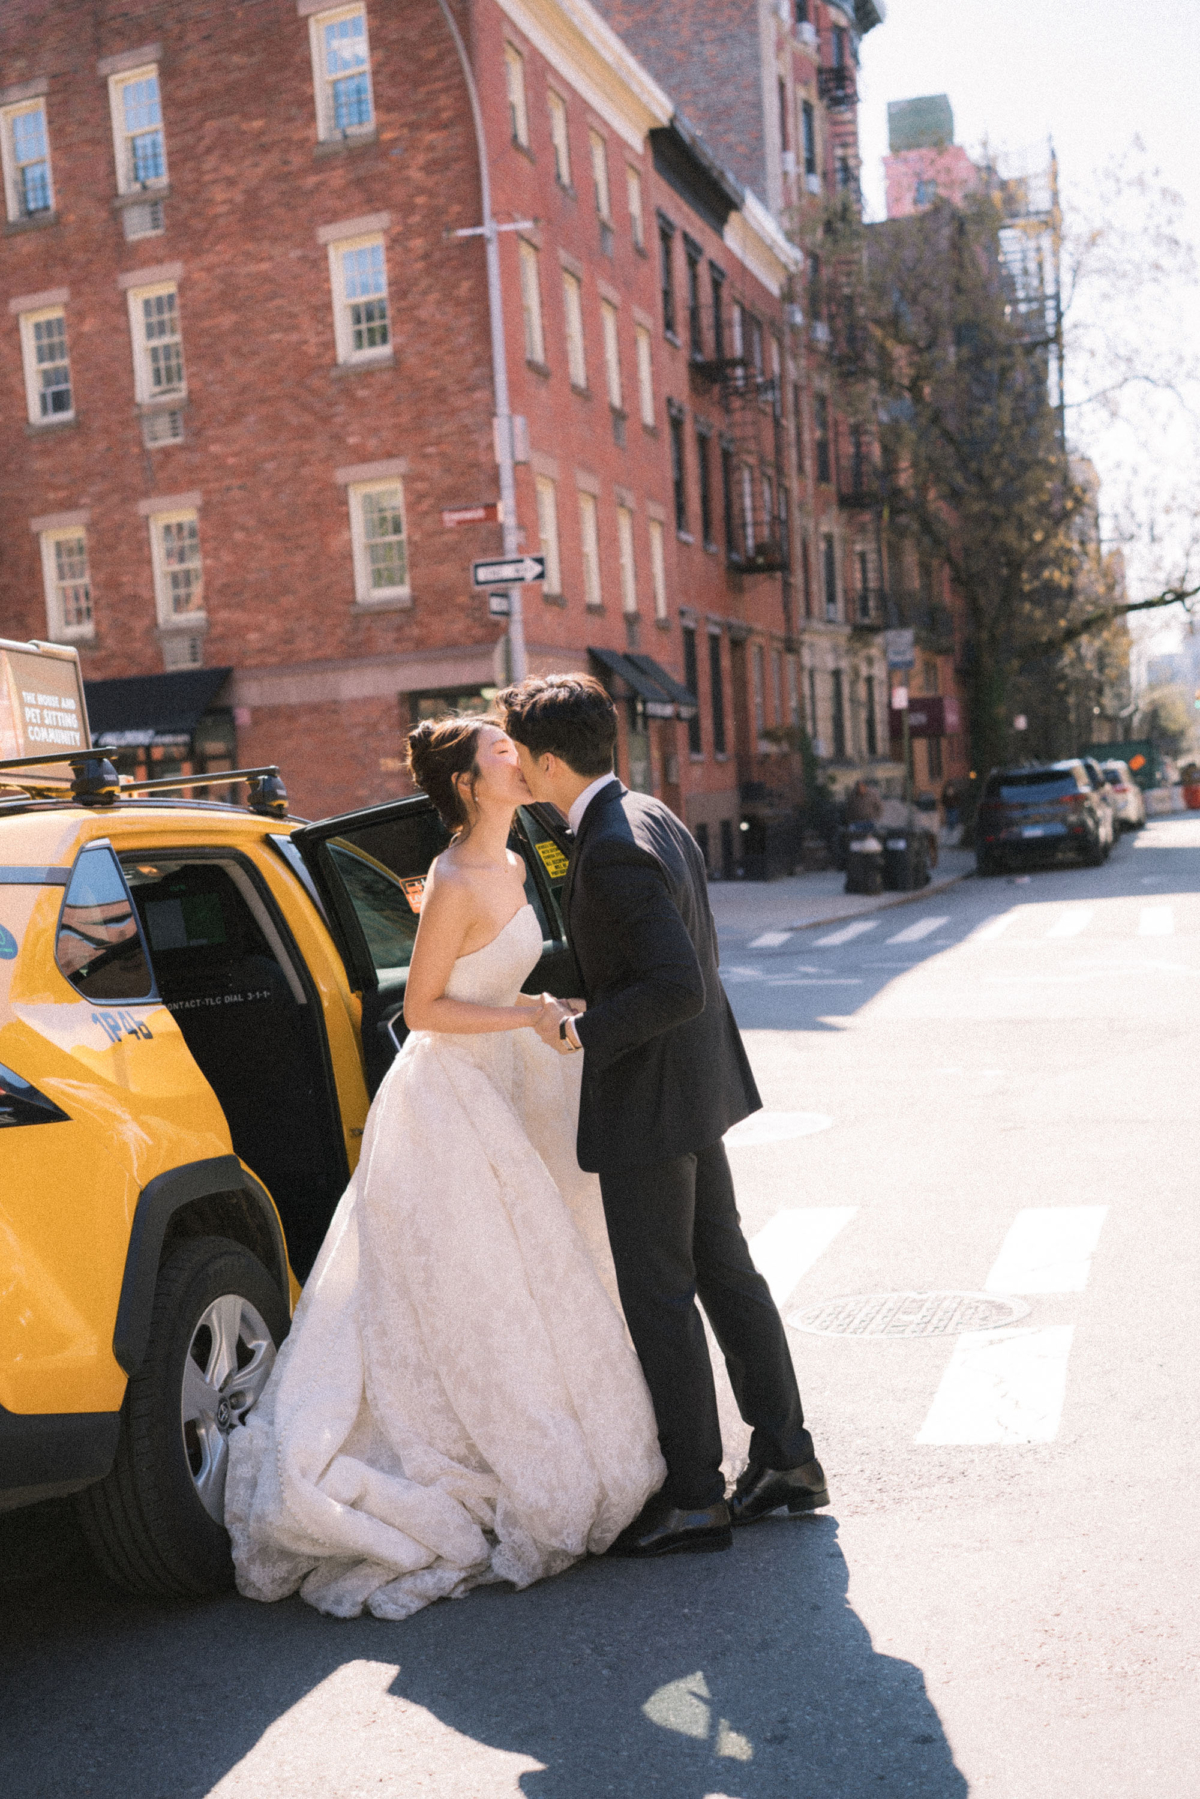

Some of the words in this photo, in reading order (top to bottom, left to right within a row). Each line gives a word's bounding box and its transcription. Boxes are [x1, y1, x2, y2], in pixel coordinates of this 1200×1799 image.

[22, 691, 36, 704] THE
[61, 697, 76, 710] AND
[24, 706, 41, 724] PET
[43, 709, 78, 728] SITTING
[28, 725, 80, 746] COMMUNITY
[224, 994, 244, 1004] DIAL
[91, 1011, 154, 1042] 1P46
